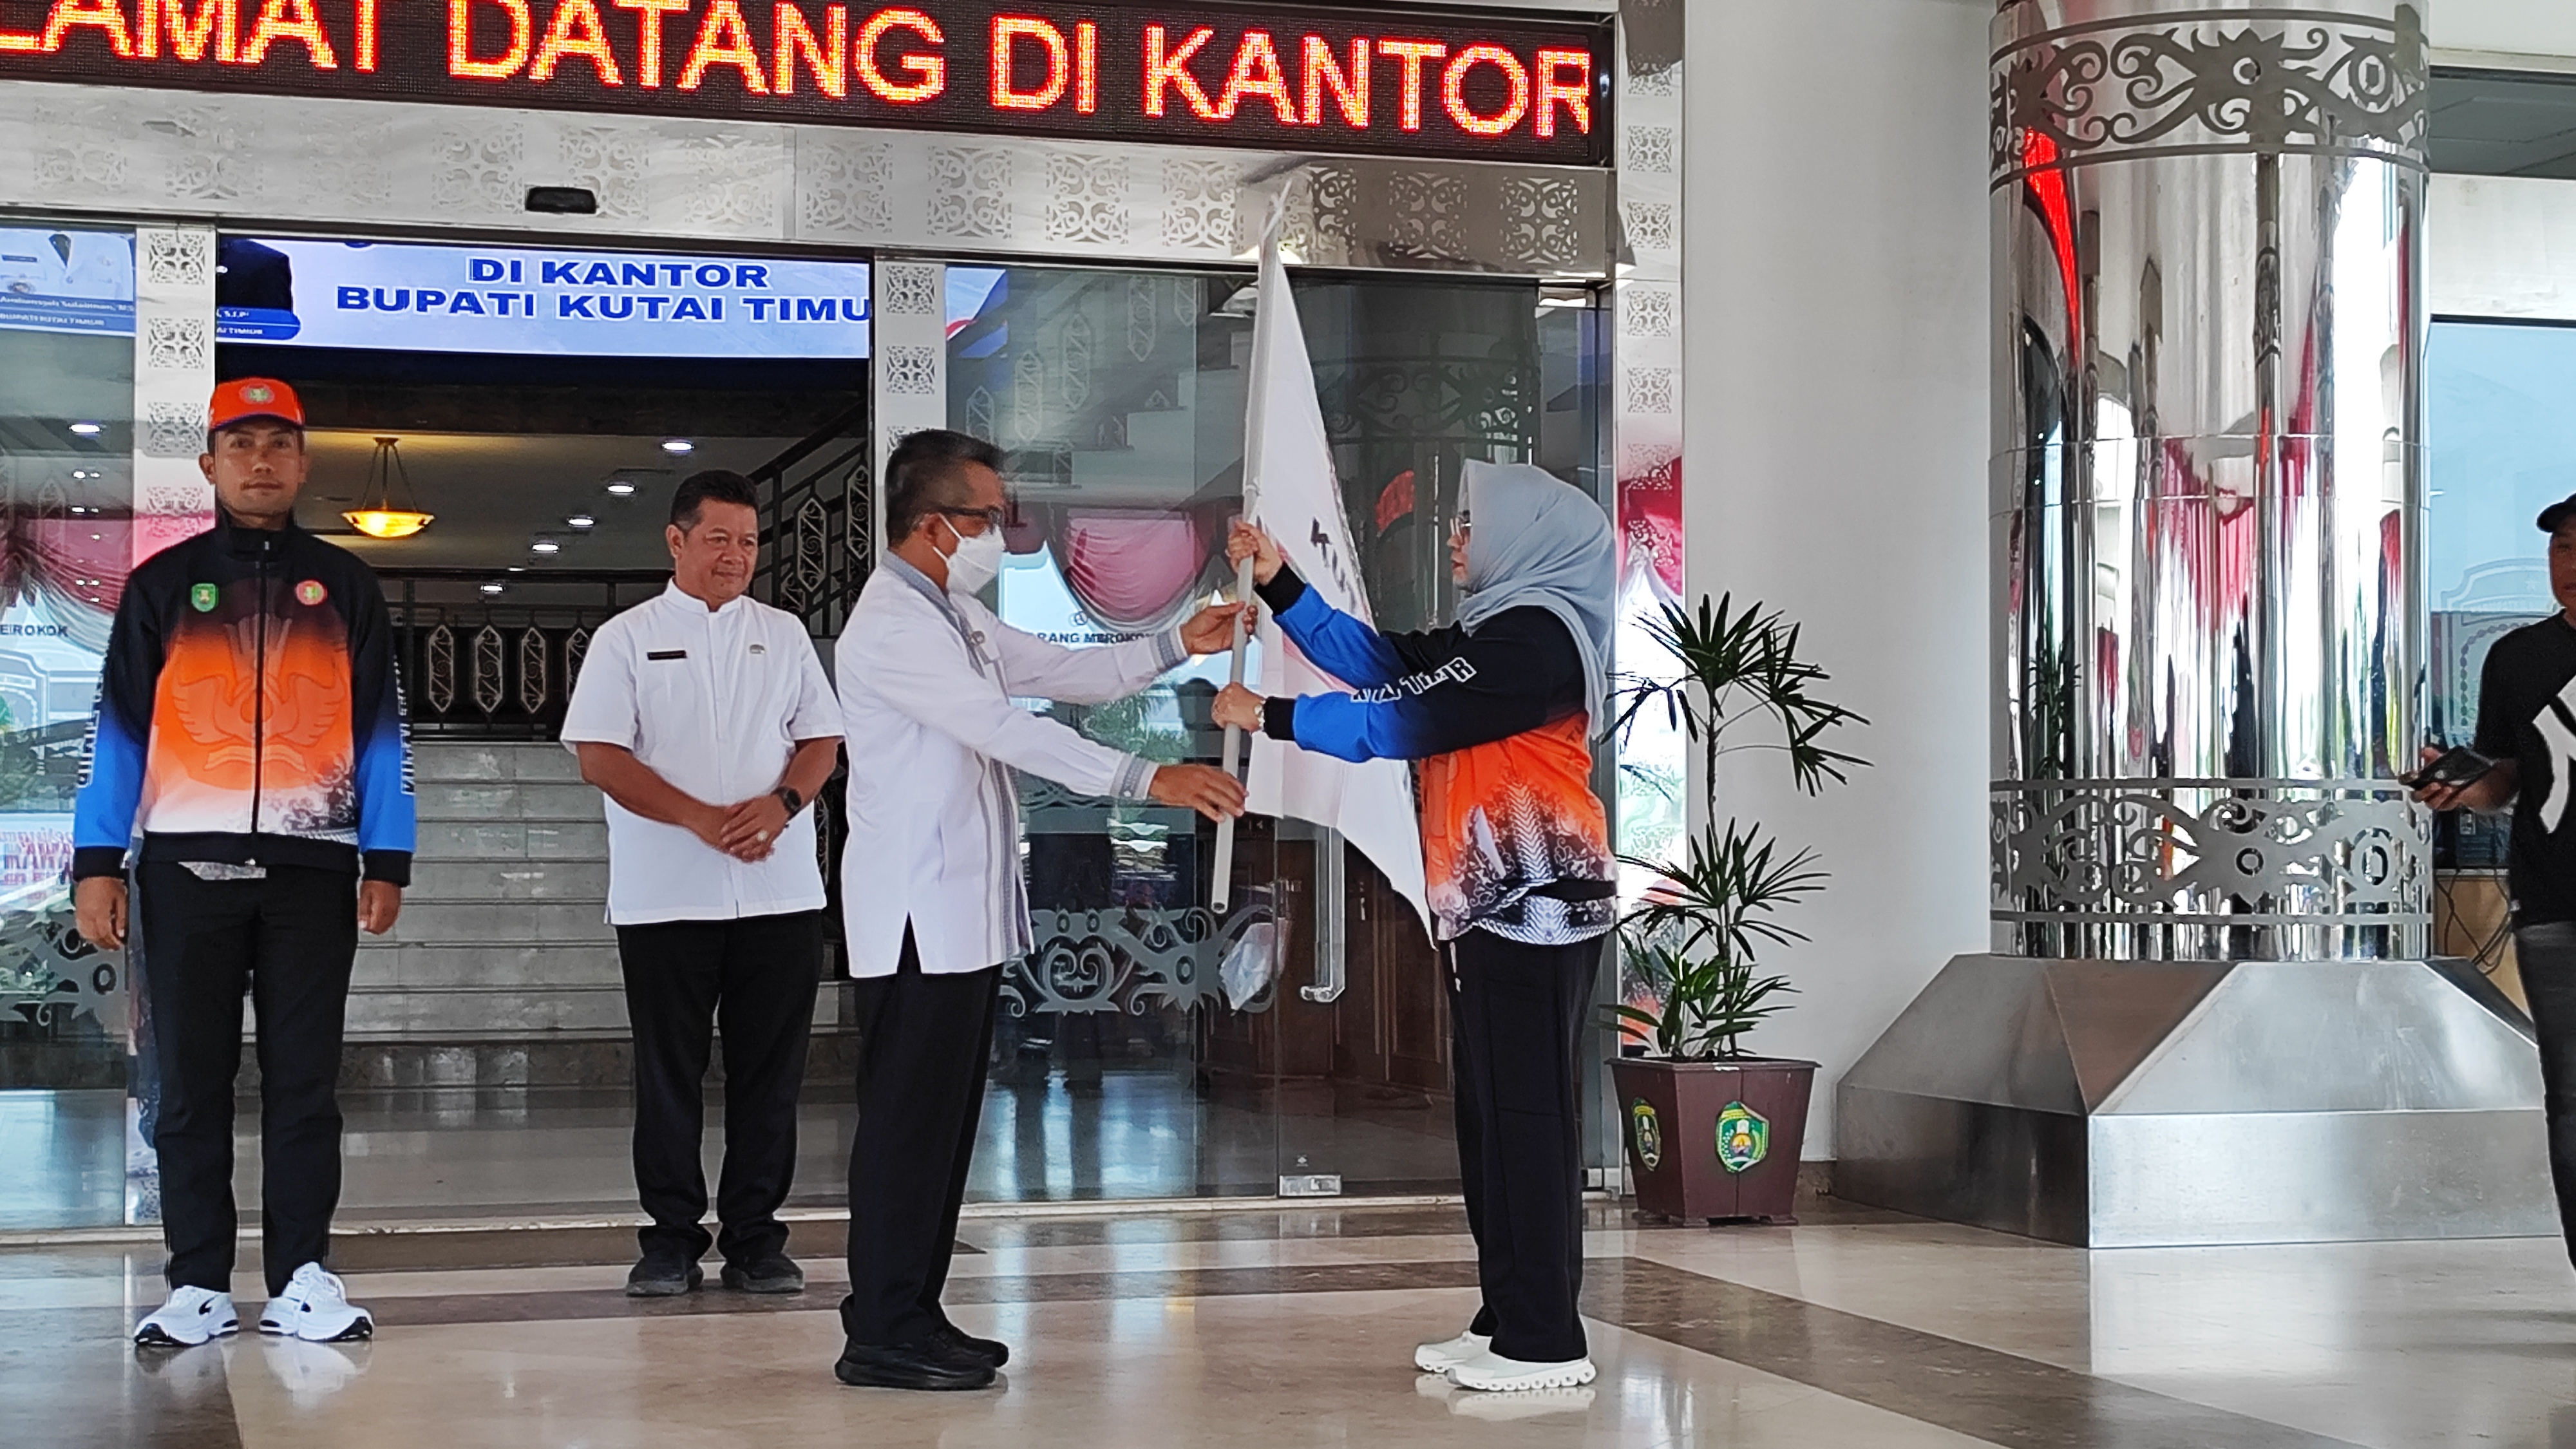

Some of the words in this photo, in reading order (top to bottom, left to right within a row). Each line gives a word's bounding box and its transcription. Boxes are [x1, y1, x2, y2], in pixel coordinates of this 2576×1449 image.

[447, 0, 945, 103] DATANG
[987, 14, 1097, 114] DI
[1142, 22, 1592, 138] KANTOR
[469, 258, 522, 283] DI
[541, 261, 769, 289] KANTOR
[337, 286, 536, 316] BUPATI
[558, 294, 724, 321] KUTAI
[743, 298, 871, 321] TIMU
